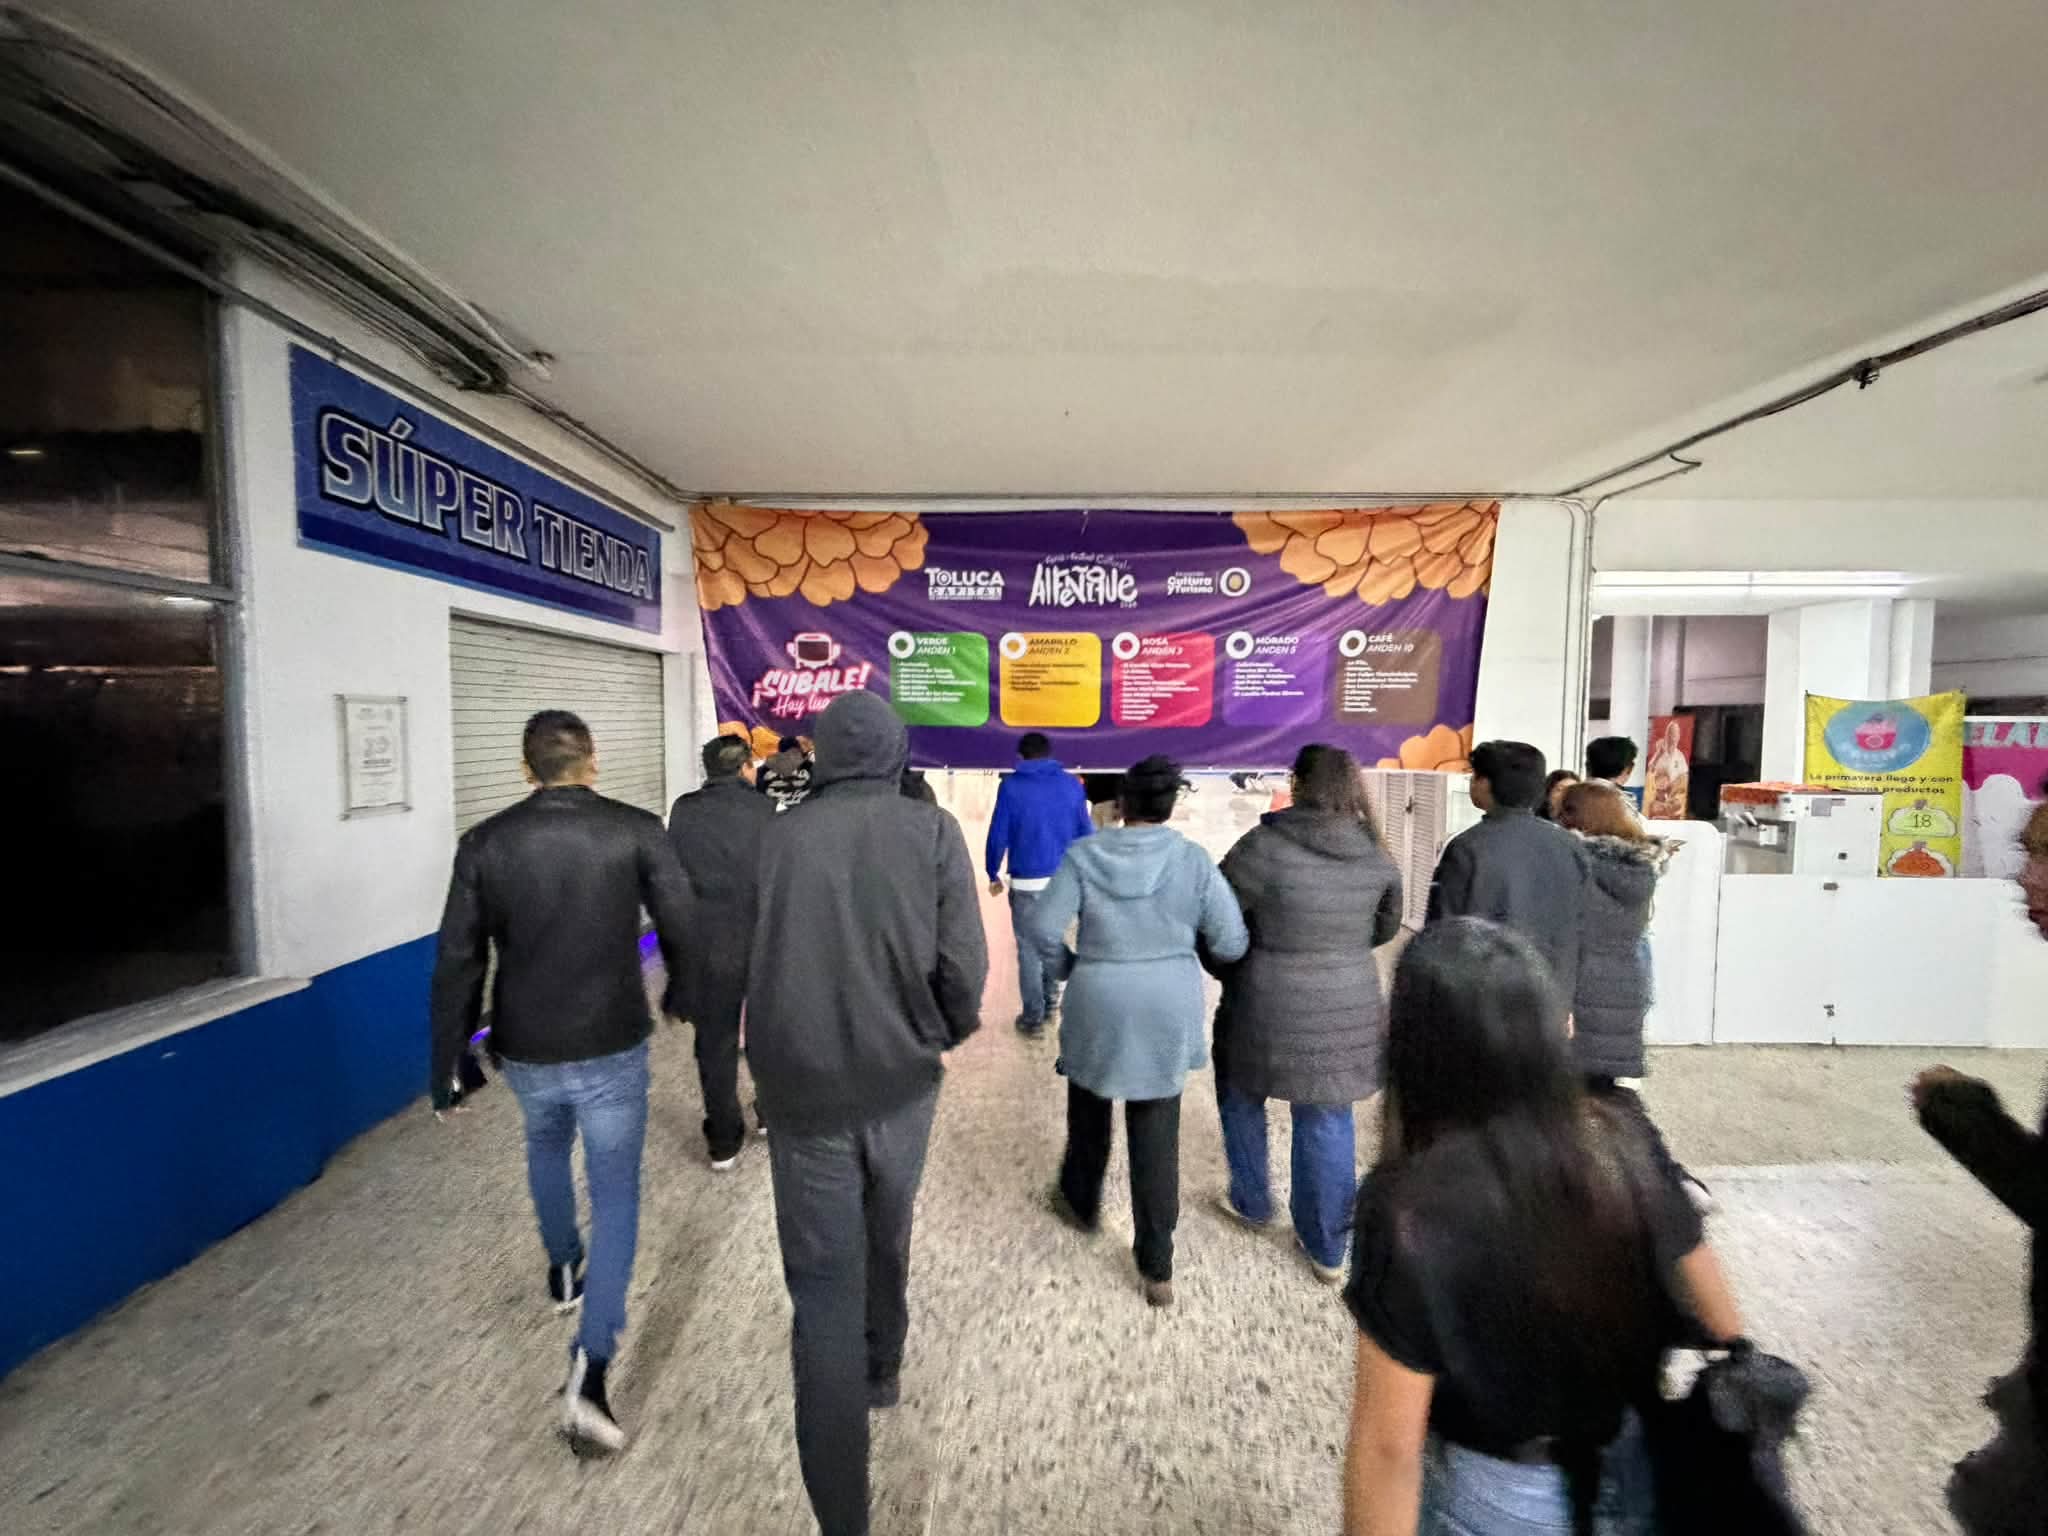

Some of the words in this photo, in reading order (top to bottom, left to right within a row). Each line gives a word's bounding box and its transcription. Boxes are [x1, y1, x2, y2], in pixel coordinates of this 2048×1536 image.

[320, 407, 527, 559] SÚPER
[534, 503, 653, 599] TIENDA
[924, 567, 1005, 586] TOLUCA
[1168, 576, 1212, 586] Cultura
[916, 637, 949, 646] VERDE
[1028, 638, 1078, 646] AMARILLO
[1141, 637, 1169, 646] ROSA
[1255, 636, 1300, 645] MORADO
[771, 696, 804, 720] Hay
[1825, 774, 1882, 783] primavera
[1882, 785, 1945, 795] productos
[1912, 813, 1932, 828] 18
